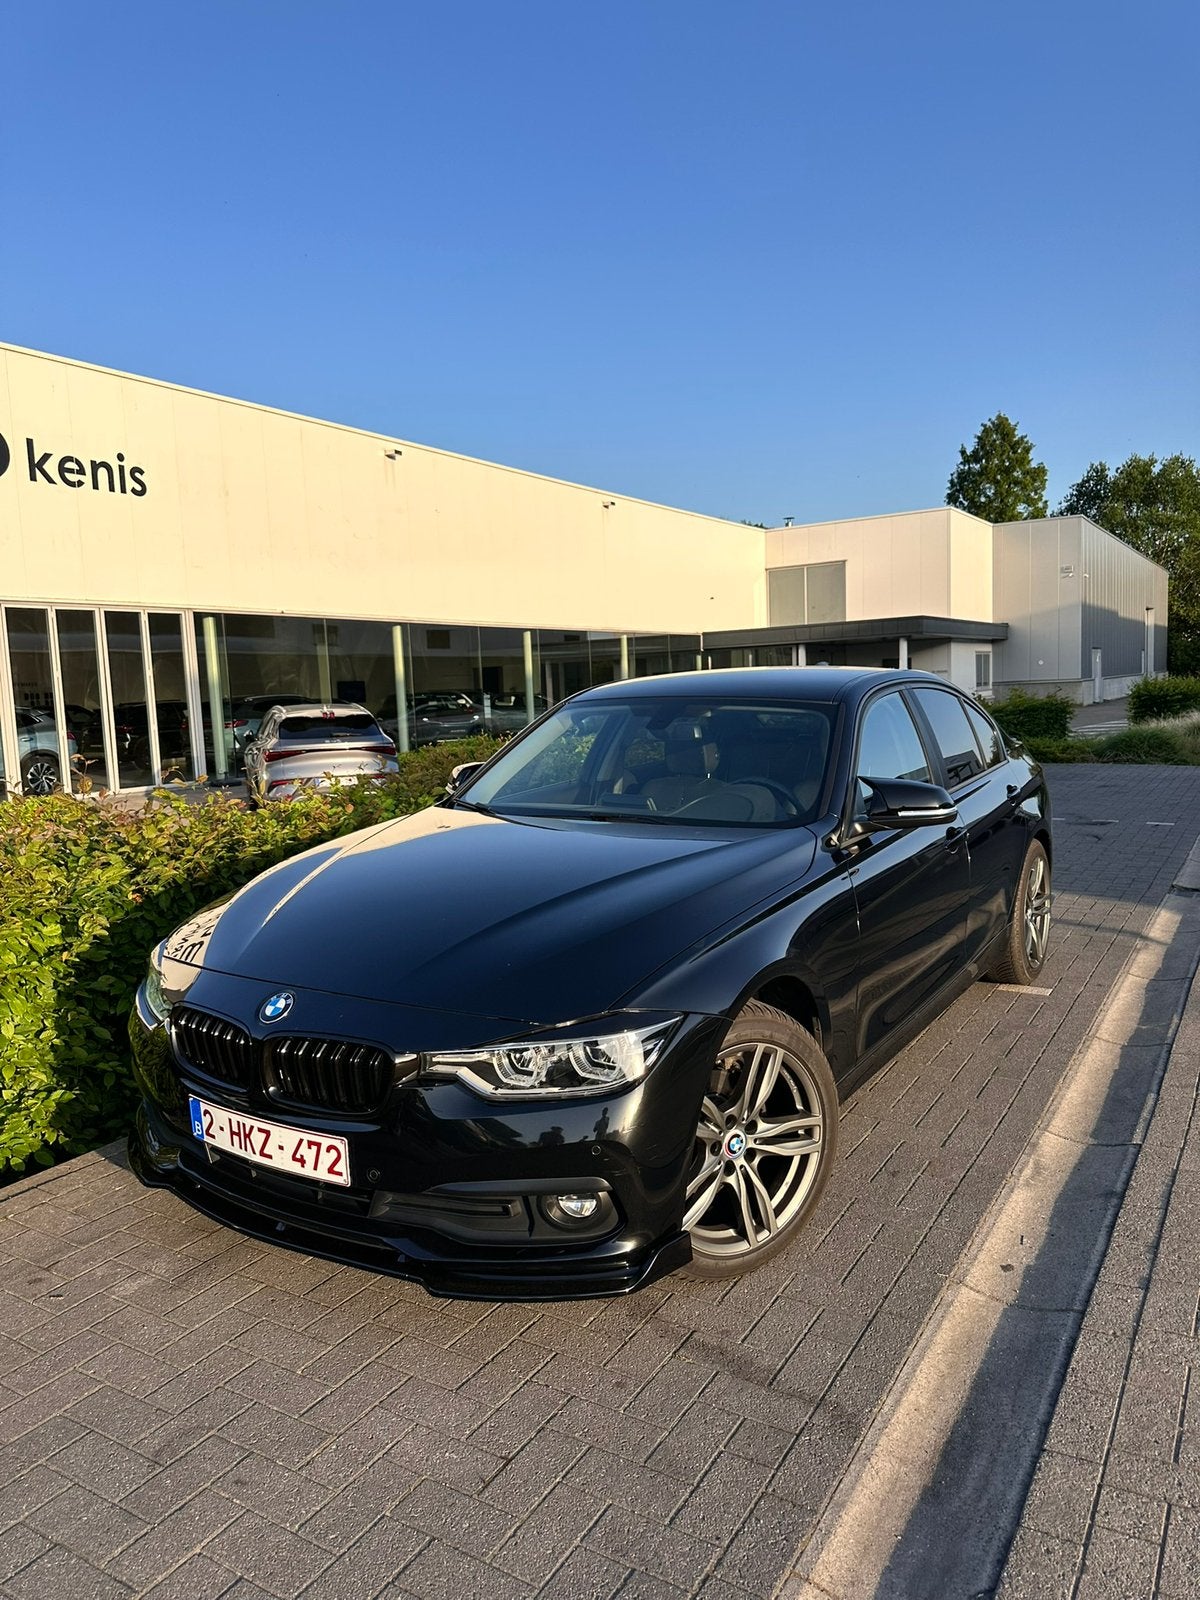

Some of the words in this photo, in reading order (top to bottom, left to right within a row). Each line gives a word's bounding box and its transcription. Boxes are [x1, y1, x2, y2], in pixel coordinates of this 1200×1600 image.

[26, 437, 147, 497] kenis
[195, 1121, 202, 1134] B
[203, 1108, 343, 1177] 2-HKZ-472
